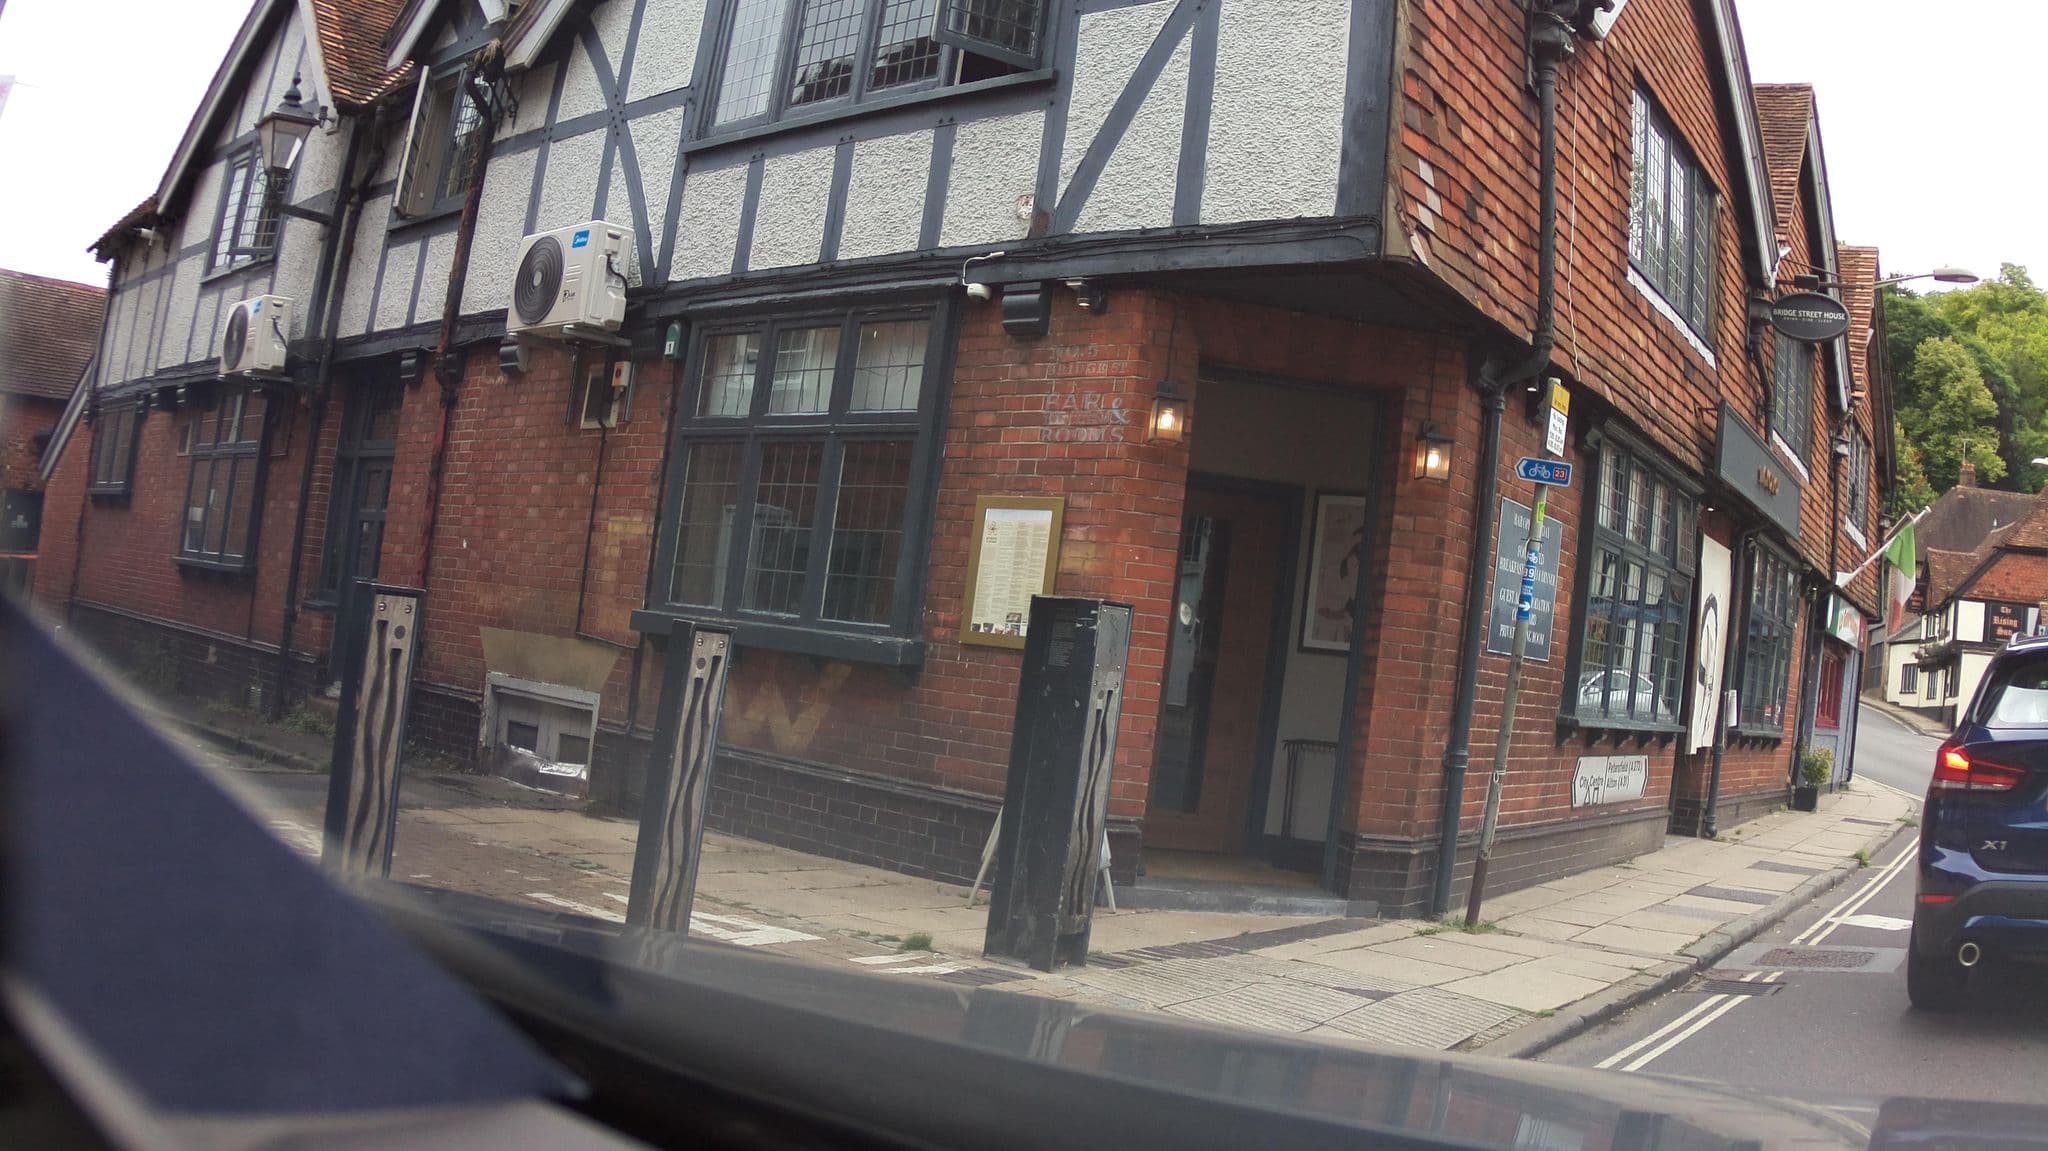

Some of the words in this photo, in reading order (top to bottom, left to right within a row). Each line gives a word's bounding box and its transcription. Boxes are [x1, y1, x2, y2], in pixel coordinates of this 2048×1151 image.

[1773, 308, 1797, 317] BRIDGE
[1798, 309, 1823, 319] STREET
[1823, 311, 1846, 320] HOUSE
[1554, 469, 1565, 478] 23
[1579, 775, 1590, 790] City
[1589, 774, 1604, 788] Centre
[1981, 840, 2008, 850] X1
